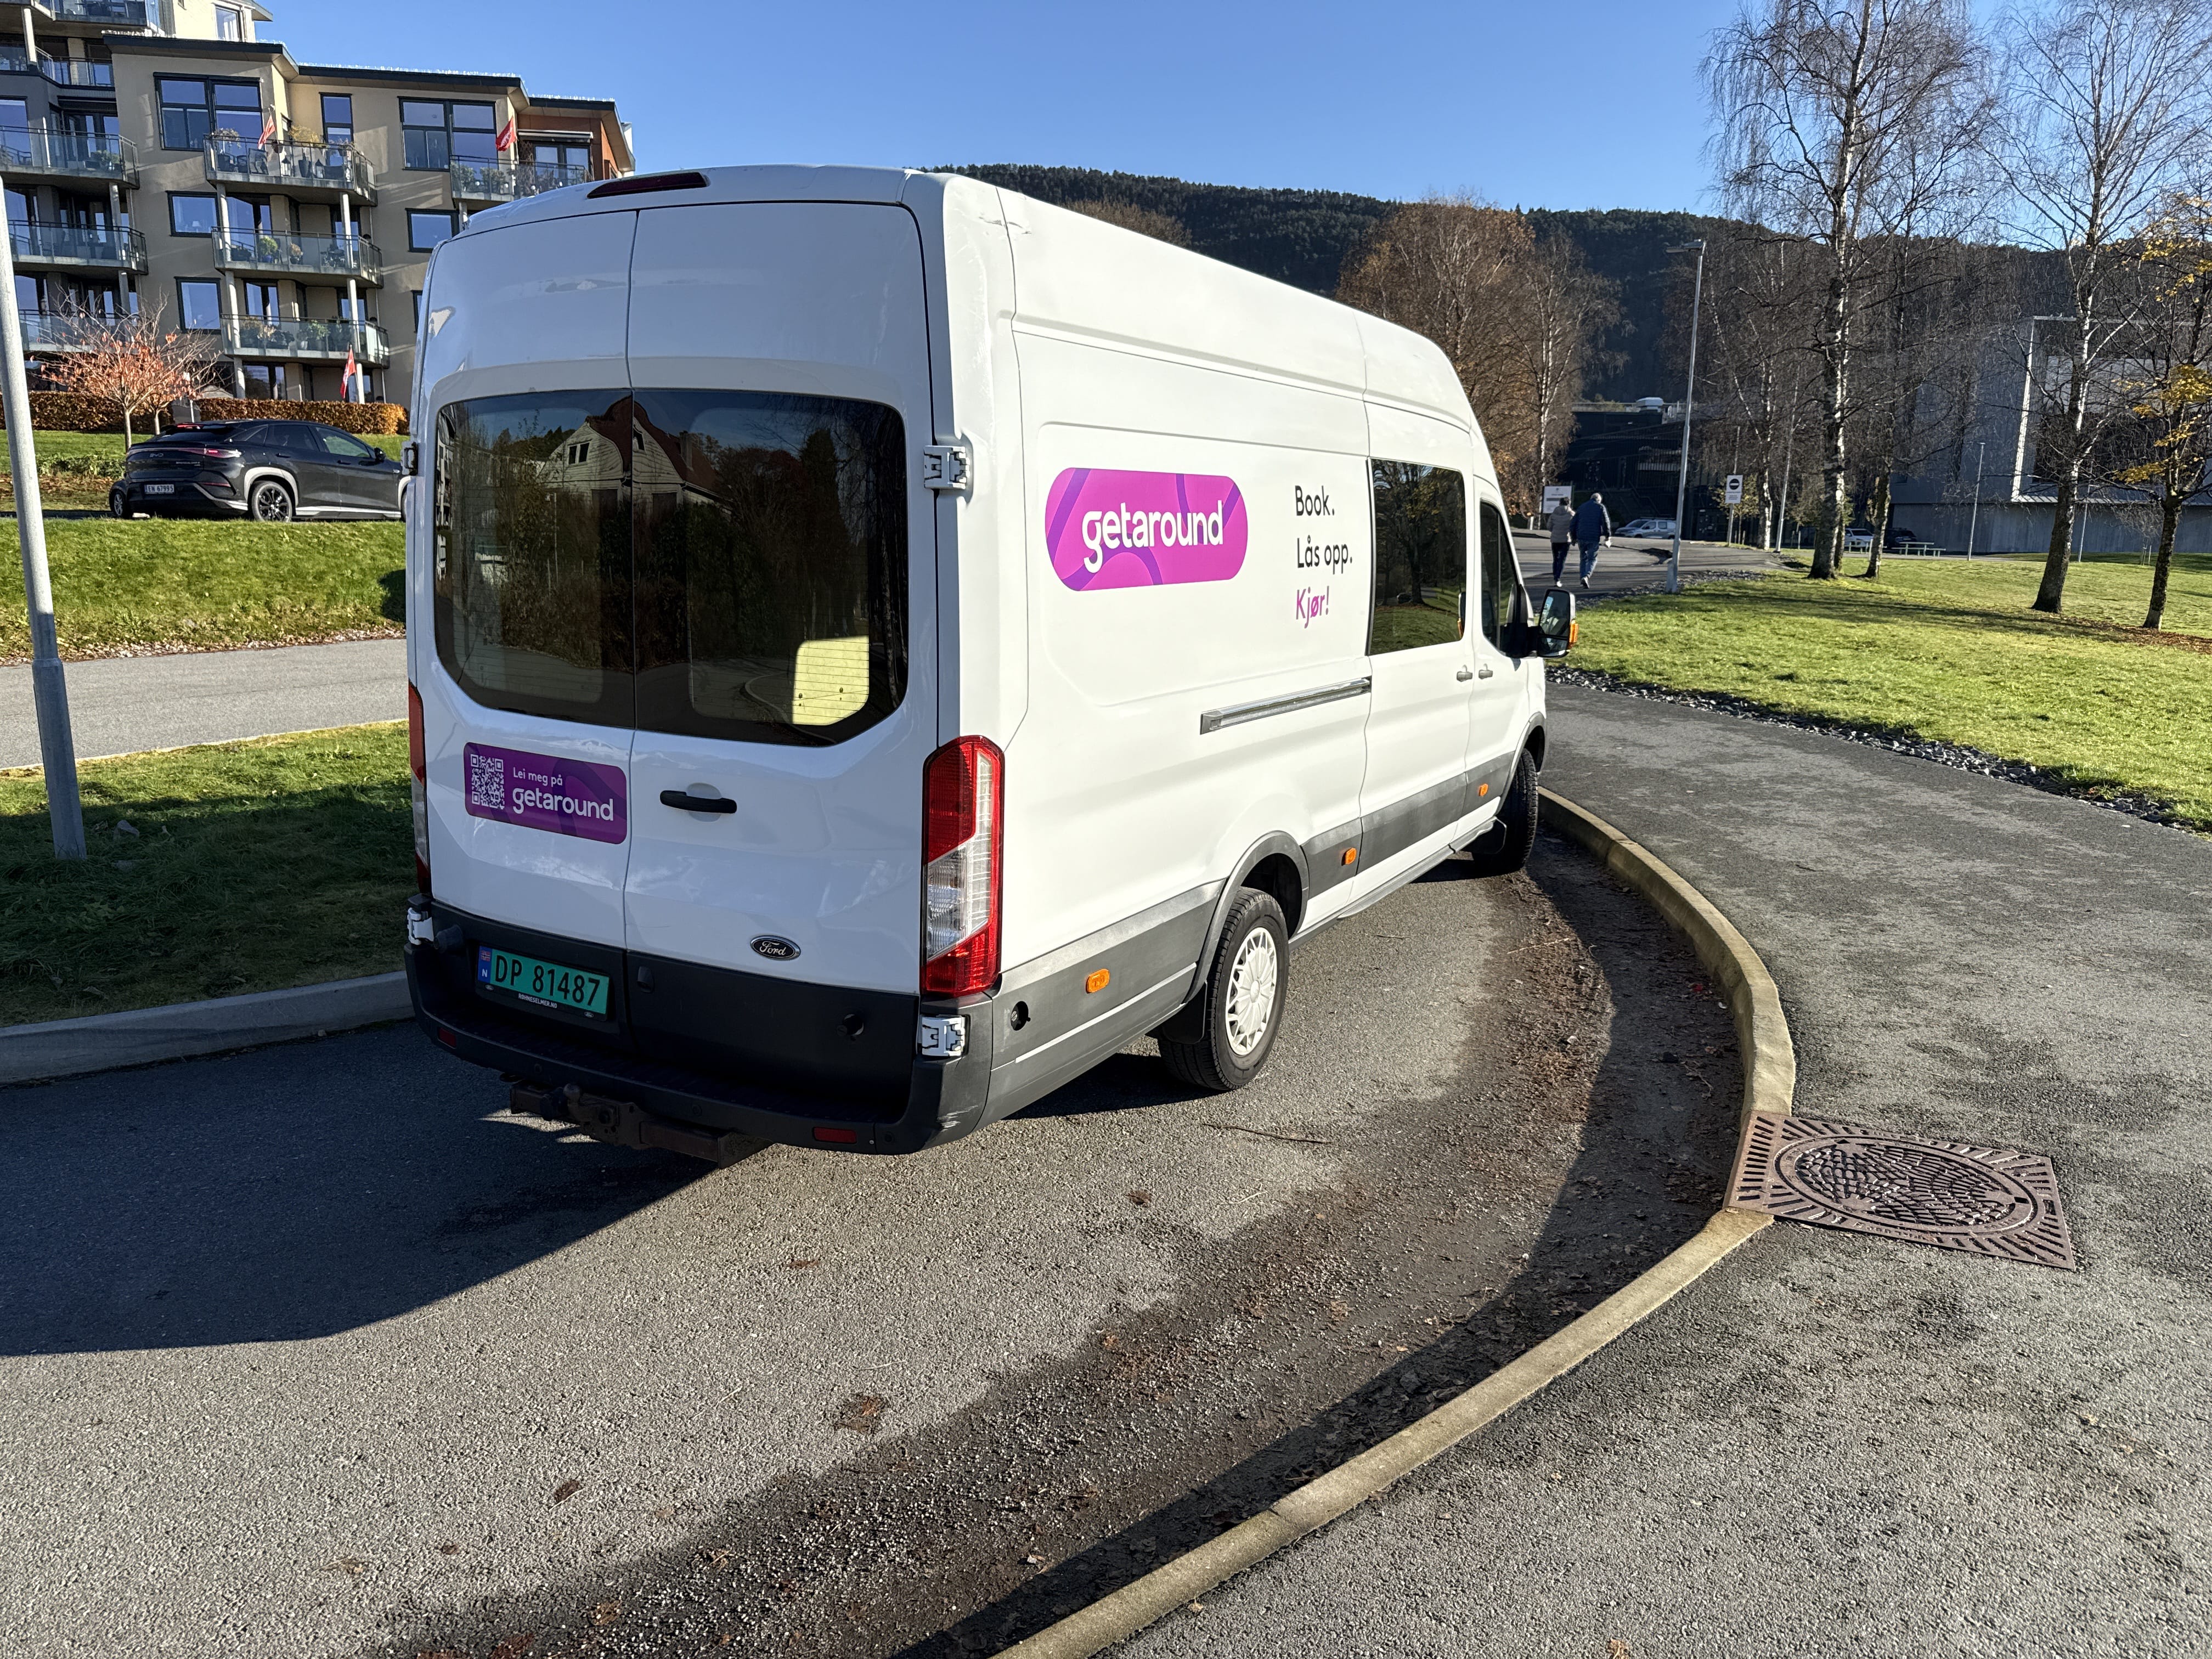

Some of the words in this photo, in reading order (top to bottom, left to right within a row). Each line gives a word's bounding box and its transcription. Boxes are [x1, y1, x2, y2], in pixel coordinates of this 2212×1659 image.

[1295, 486, 1335, 516] Book.
[1081, 500, 1223, 574] getaround
[1296, 534, 1320, 568] Lås
[1324, 543, 1353, 575] opp.
[1295, 585, 1330, 629] Kjør!
[513, 766, 526, 779] Lei
[528, 772, 548, 786] meg
[550, 774, 563, 787] på
[512, 788, 614, 821] getaround
[759, 940, 787, 956] Ford
[482, 968, 488, 978] N
[495, 955, 523, 986] DP
[532, 964, 601, 1007] 81487
